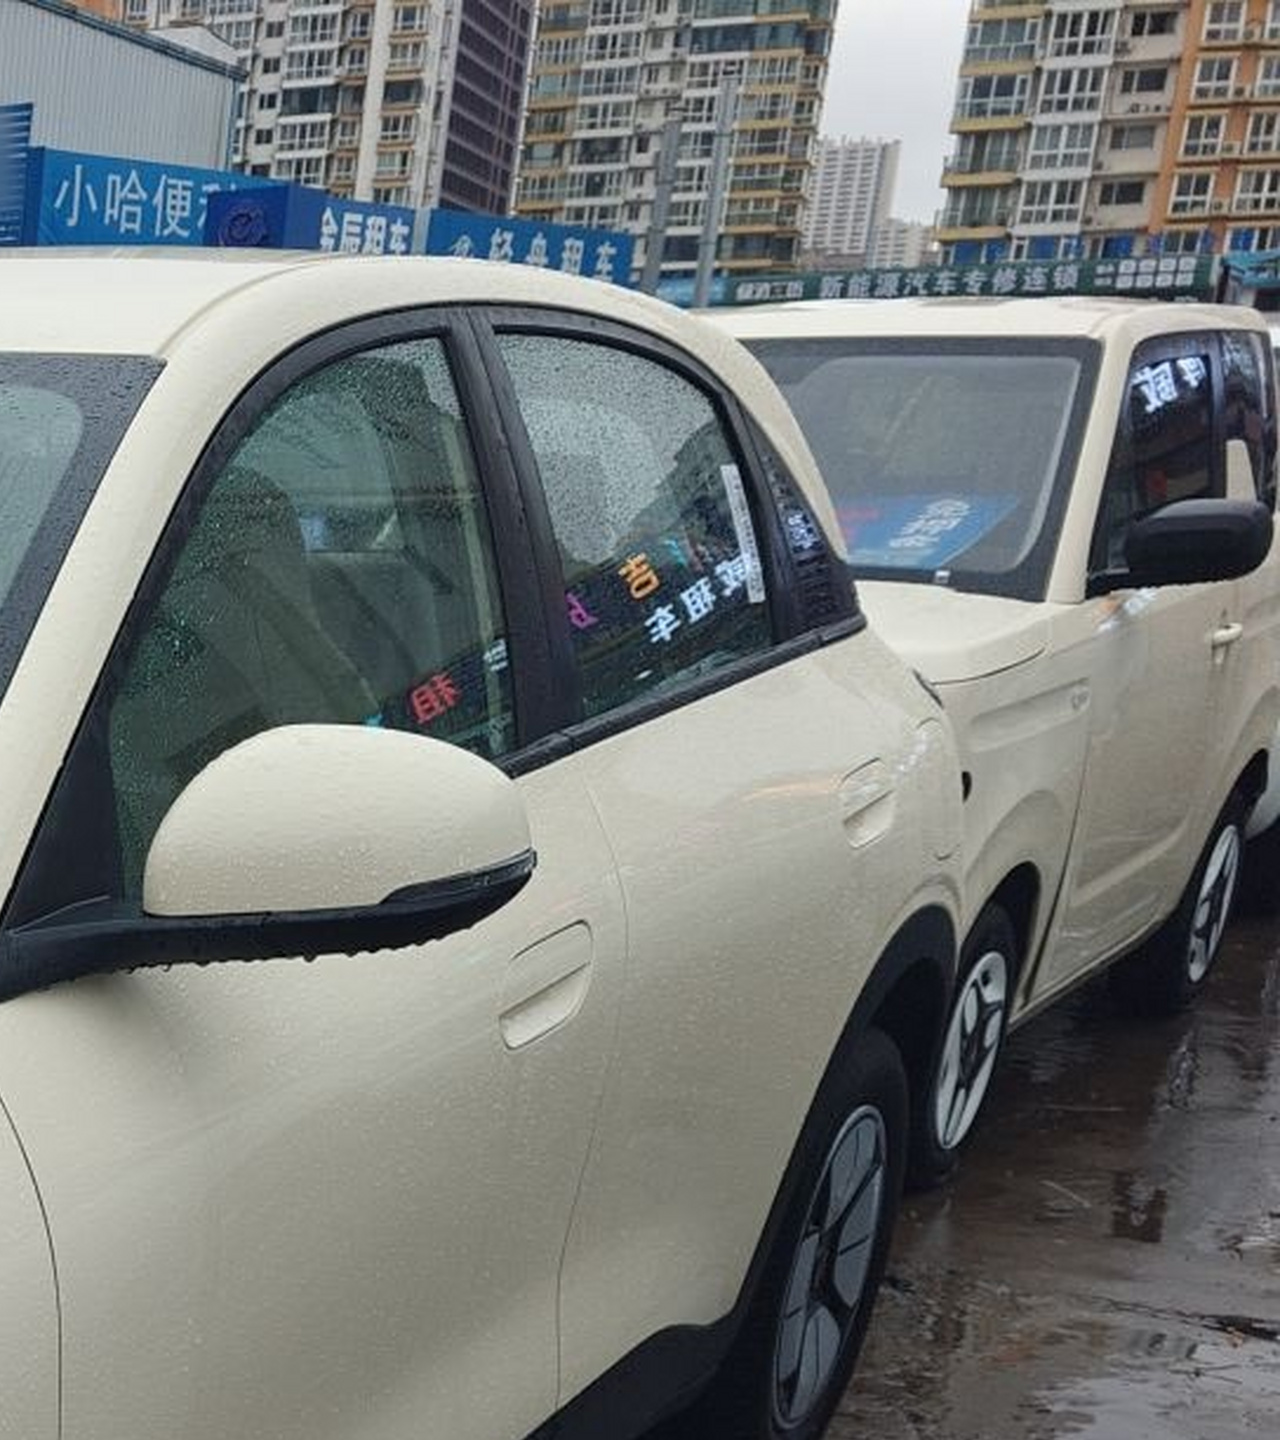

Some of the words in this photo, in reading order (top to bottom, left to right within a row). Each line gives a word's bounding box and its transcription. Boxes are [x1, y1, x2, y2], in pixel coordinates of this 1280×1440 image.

[819, 265, 1079, 298] 新能源汽车专修连锁
